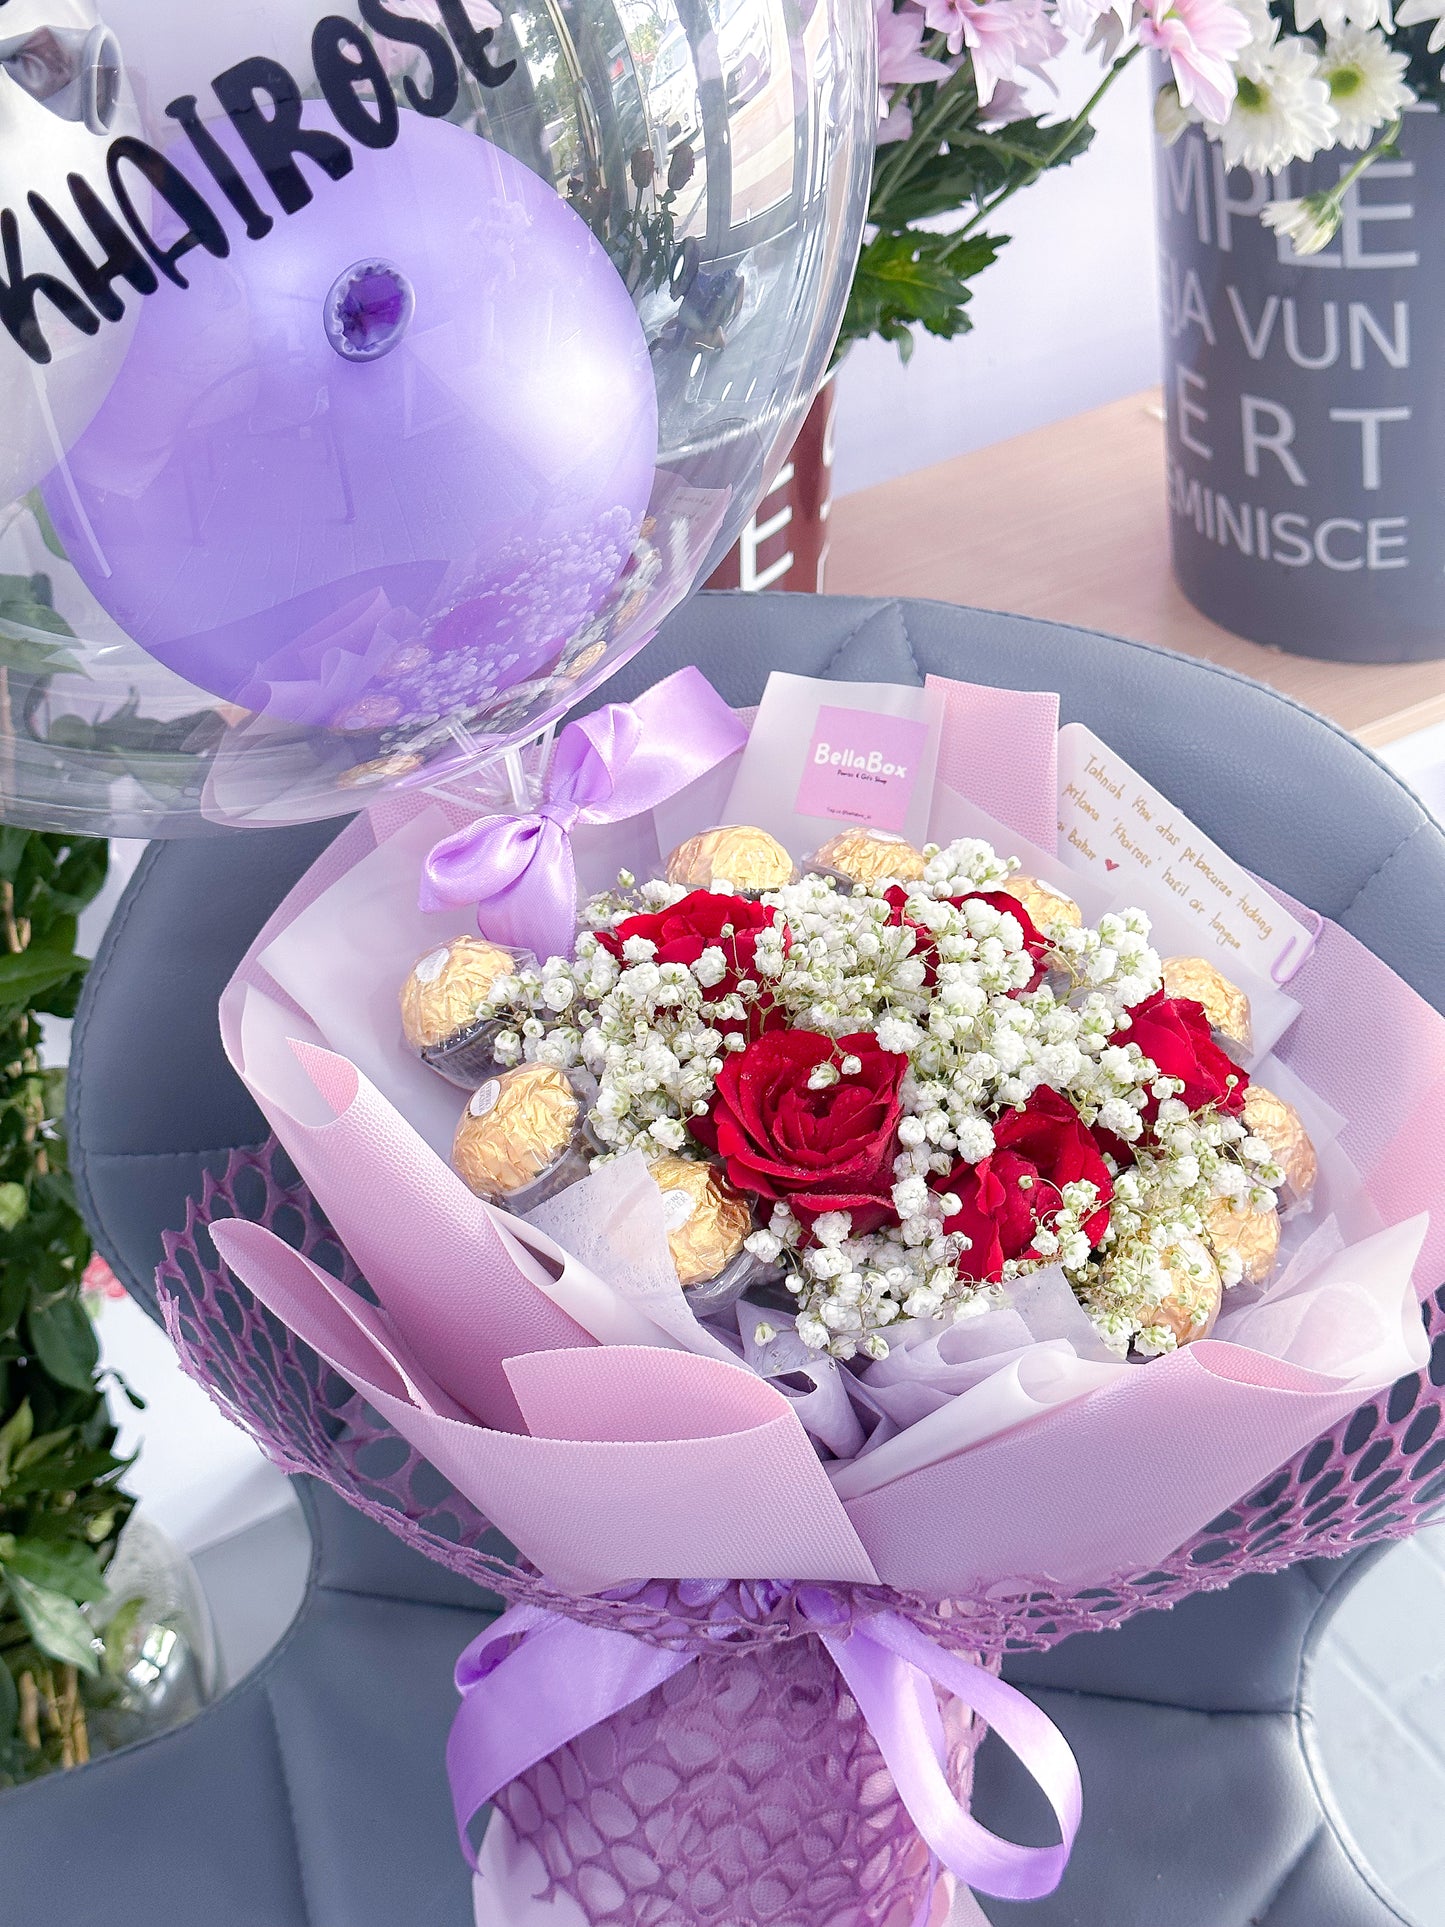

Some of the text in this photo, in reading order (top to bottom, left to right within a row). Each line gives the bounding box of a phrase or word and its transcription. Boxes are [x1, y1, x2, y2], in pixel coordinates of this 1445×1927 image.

[1169, 457, 1409, 571] MINISCE
[814, 743, 907, 778] BellaBox
[1084, 753, 1126, 799] Tahniah
